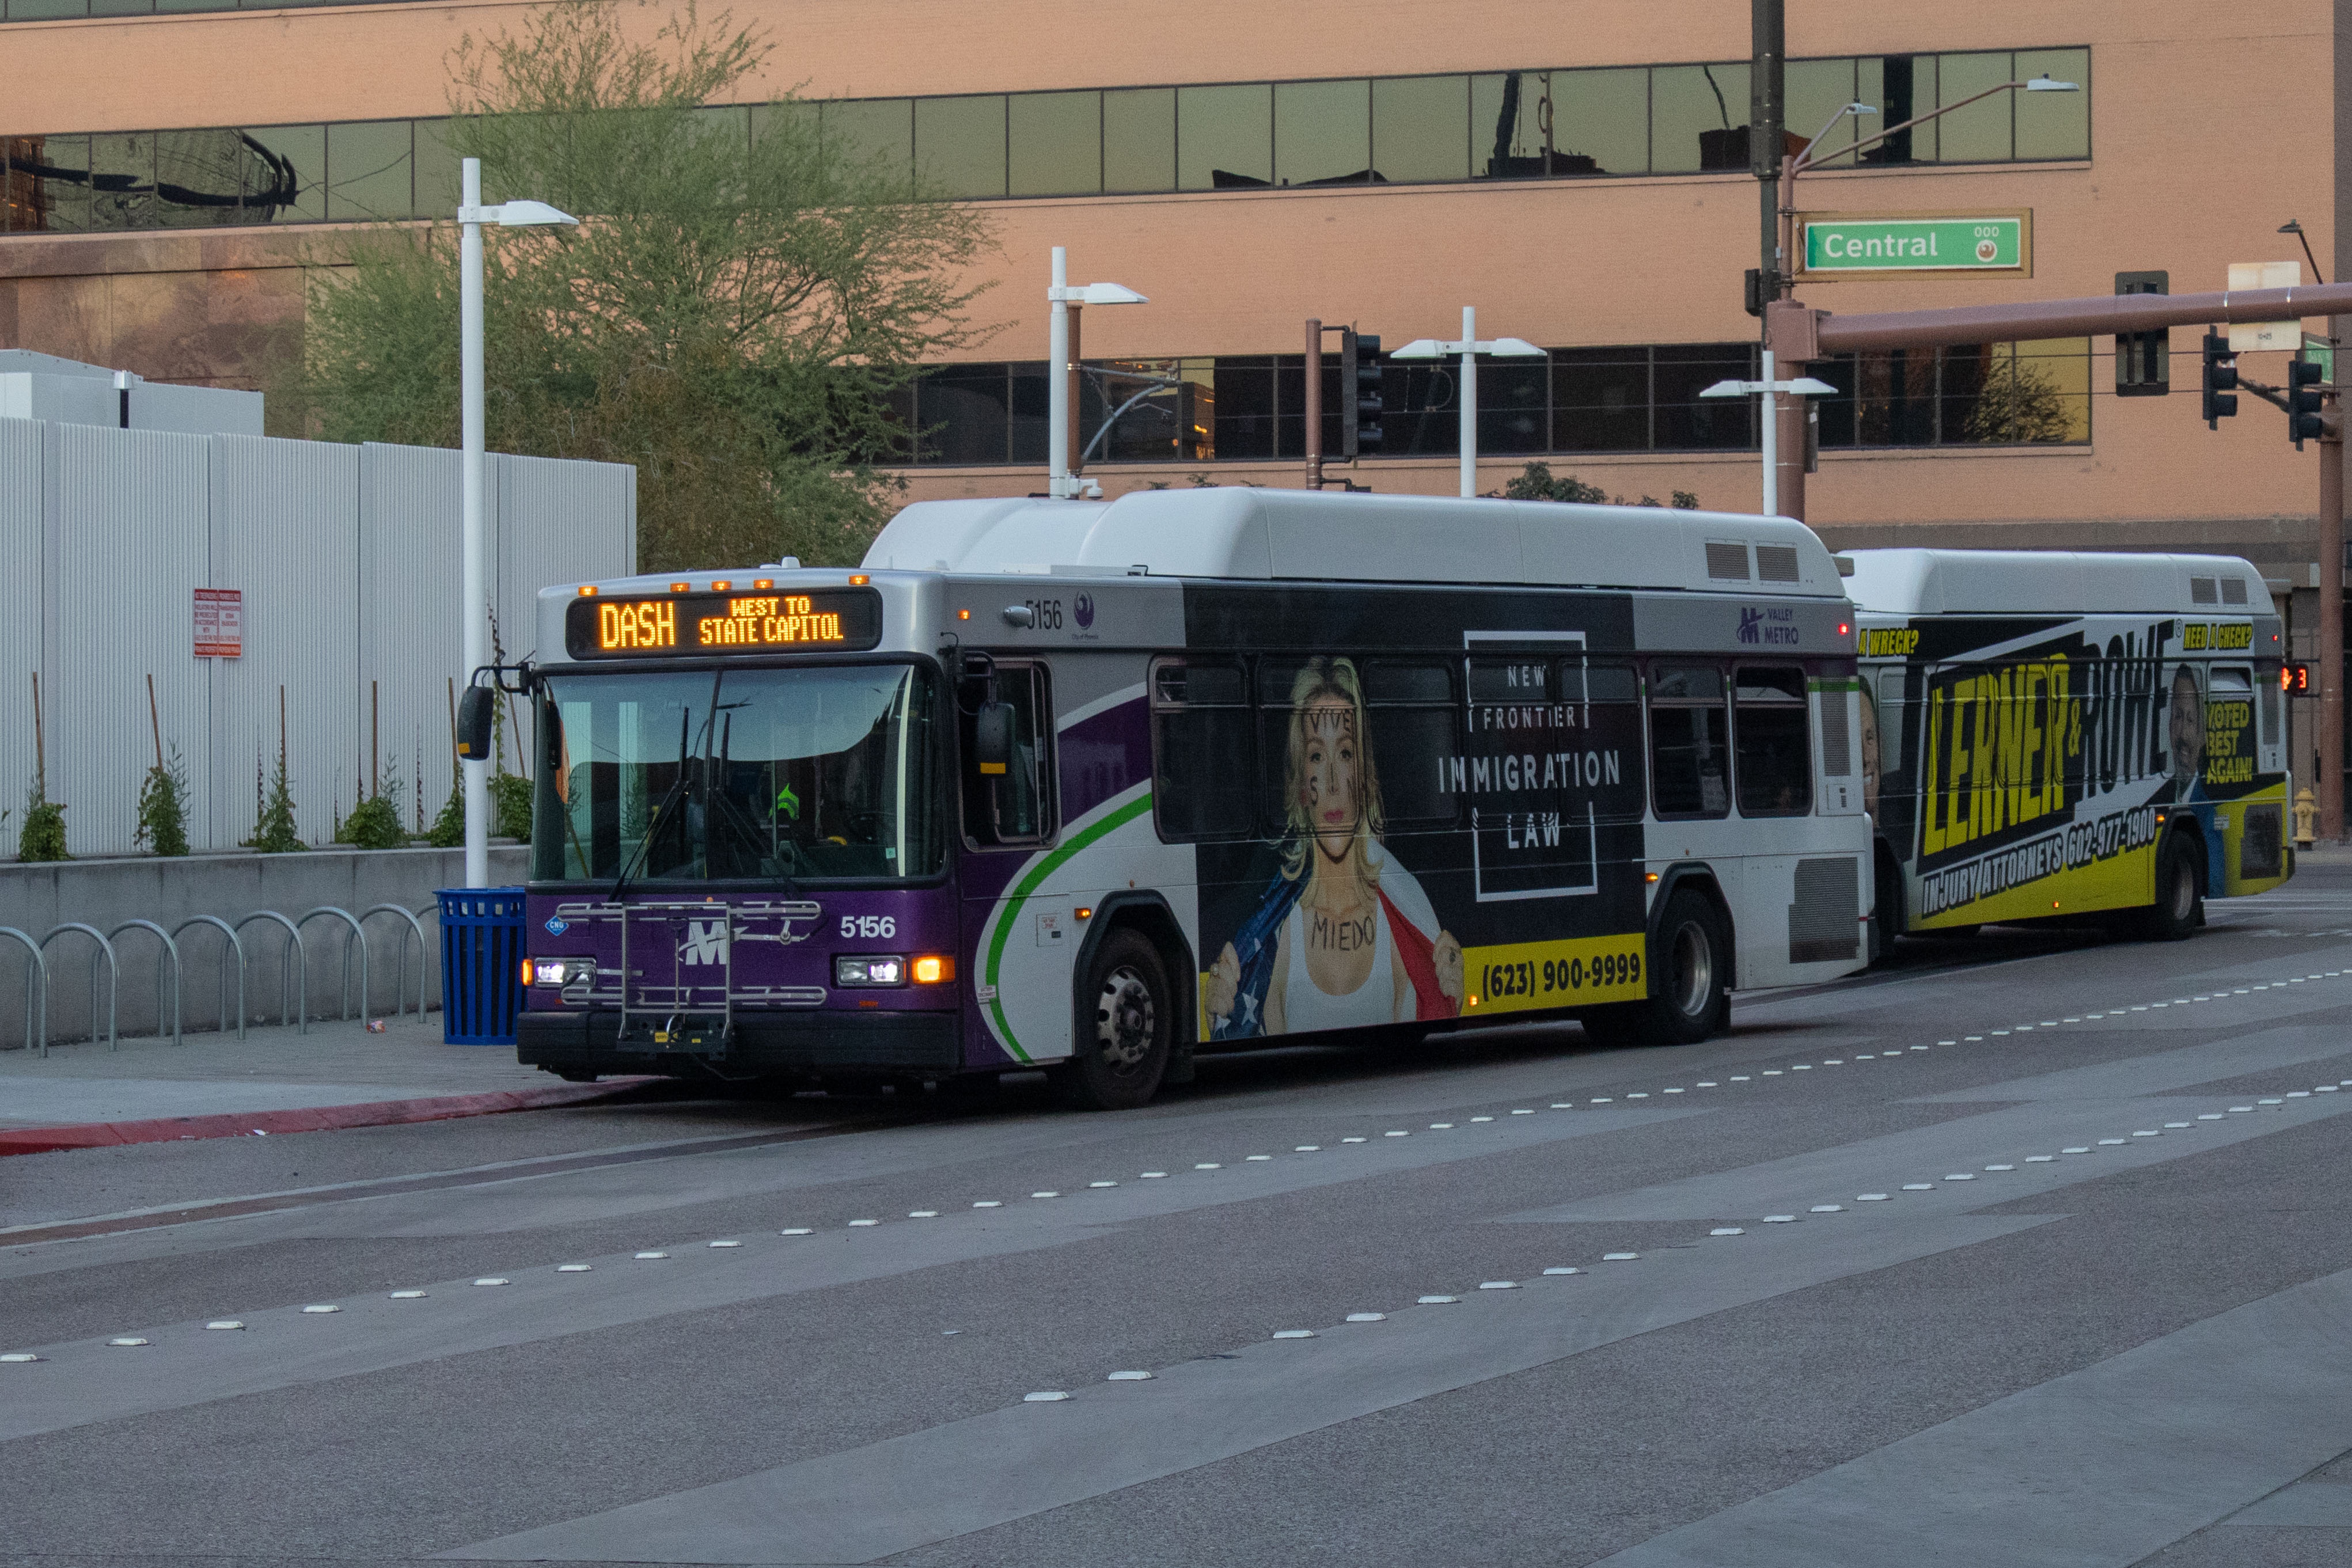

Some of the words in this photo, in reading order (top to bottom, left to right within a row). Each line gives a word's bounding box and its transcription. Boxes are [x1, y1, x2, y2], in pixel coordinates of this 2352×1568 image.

[1824, 232, 1938, 258] Central
[1974, 226, 2000, 238] 000
[730, 597, 779, 617] WEST
[785, 596, 811, 615] TO
[1026, 599, 1063, 630] 5156
[1767, 608, 1793, 621] VALLEY
[600, 601, 675, 648] DASH
[699, 617, 759, 644] STATE
[764, 613, 844, 643] CAPITOL
[1765, 626, 1799, 644] METRO
[2183, 624, 2209, 650] NEED
[2209, 624, 2217, 650] A
[2217, 623, 2253, 650] CHECK?
[1858, 628, 1867, 656] A
[1869, 628, 1919, 656] WRECK?
[1508, 665, 1547, 687] NEW
[2298, 668, 2307, 689] 3
[1484, 705, 1576, 730] FRONTIER
[2207, 702, 2249, 730] VOTED
[1924, 652, 2070, 856] LERNER
[2069, 698, 2082, 758] &
[2076, 620, 2175, 802] ROWE
[2206, 730, 2240, 756] BEST
[1438, 749, 1620, 794] IMMIGRATION
[2206, 757, 2254, 785] AGAIN!
[1507, 811, 1560, 849] LAW
[1922, 870, 1978, 914] INJURY
[1981, 833, 2063, 895] ATTORNEYS
[2066, 807, 2156, 865] 602-977-1900
[840, 915, 896, 939] 5156
[1311, 911, 1375, 951] MIEDO
[1482, 960, 1536, 1002] (623)
[1543, 952, 1641, 992] 900-9999
